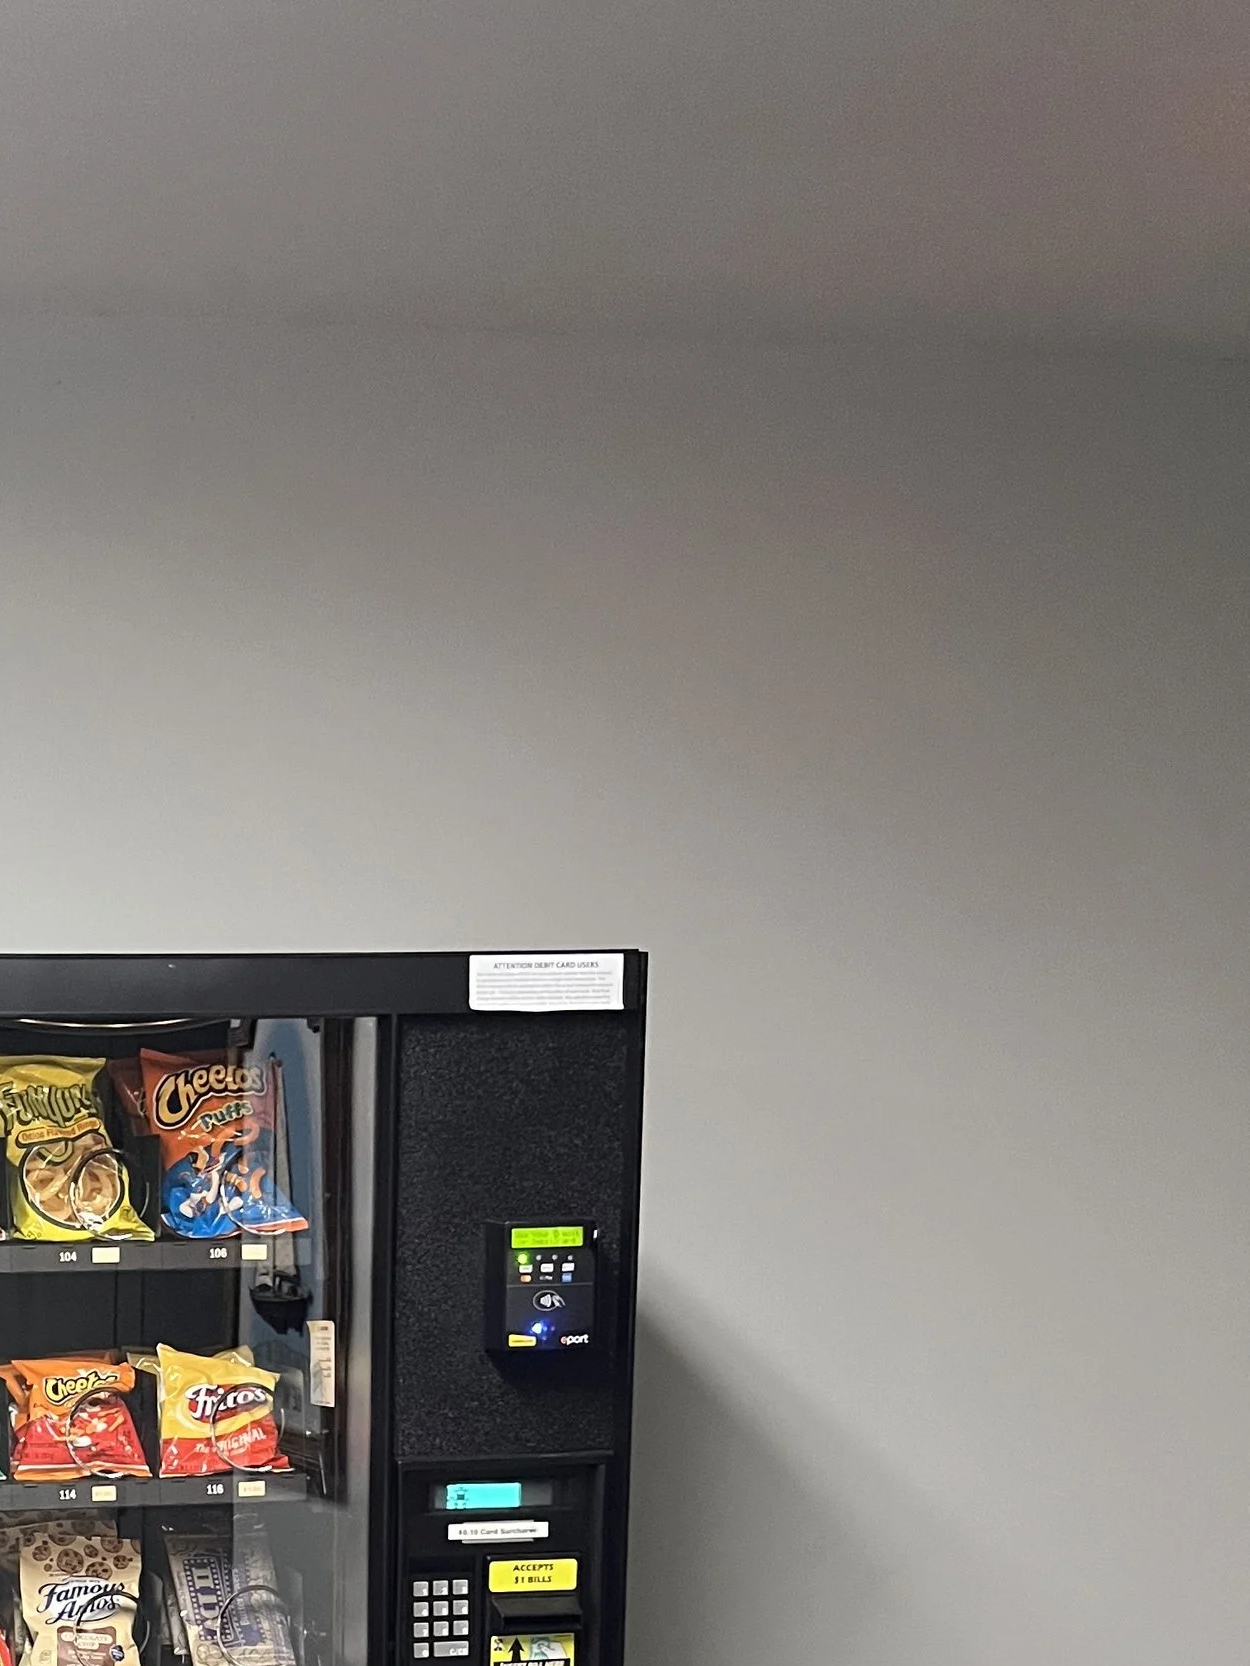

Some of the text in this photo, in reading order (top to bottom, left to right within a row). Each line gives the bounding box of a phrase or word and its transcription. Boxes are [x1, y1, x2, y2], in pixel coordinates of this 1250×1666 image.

[494, 960, 599, 969] ATTENTION DEBIT CARD USERS
[157, 1064, 265, 1127] Cheetos
[200, 1101, 253, 1131] Puffs
[59, 1251, 77, 1263] 104
[209, 1247, 227, 1259] 106
[59, 1489, 77, 1500] 114
[206, 1483, 224, 1495] 116
[513, 1563, 554, 1572] ACCEPTS
[514, 1575, 553, 1584] $1 BILLS
[37, 1582, 125, 1613] Famous
